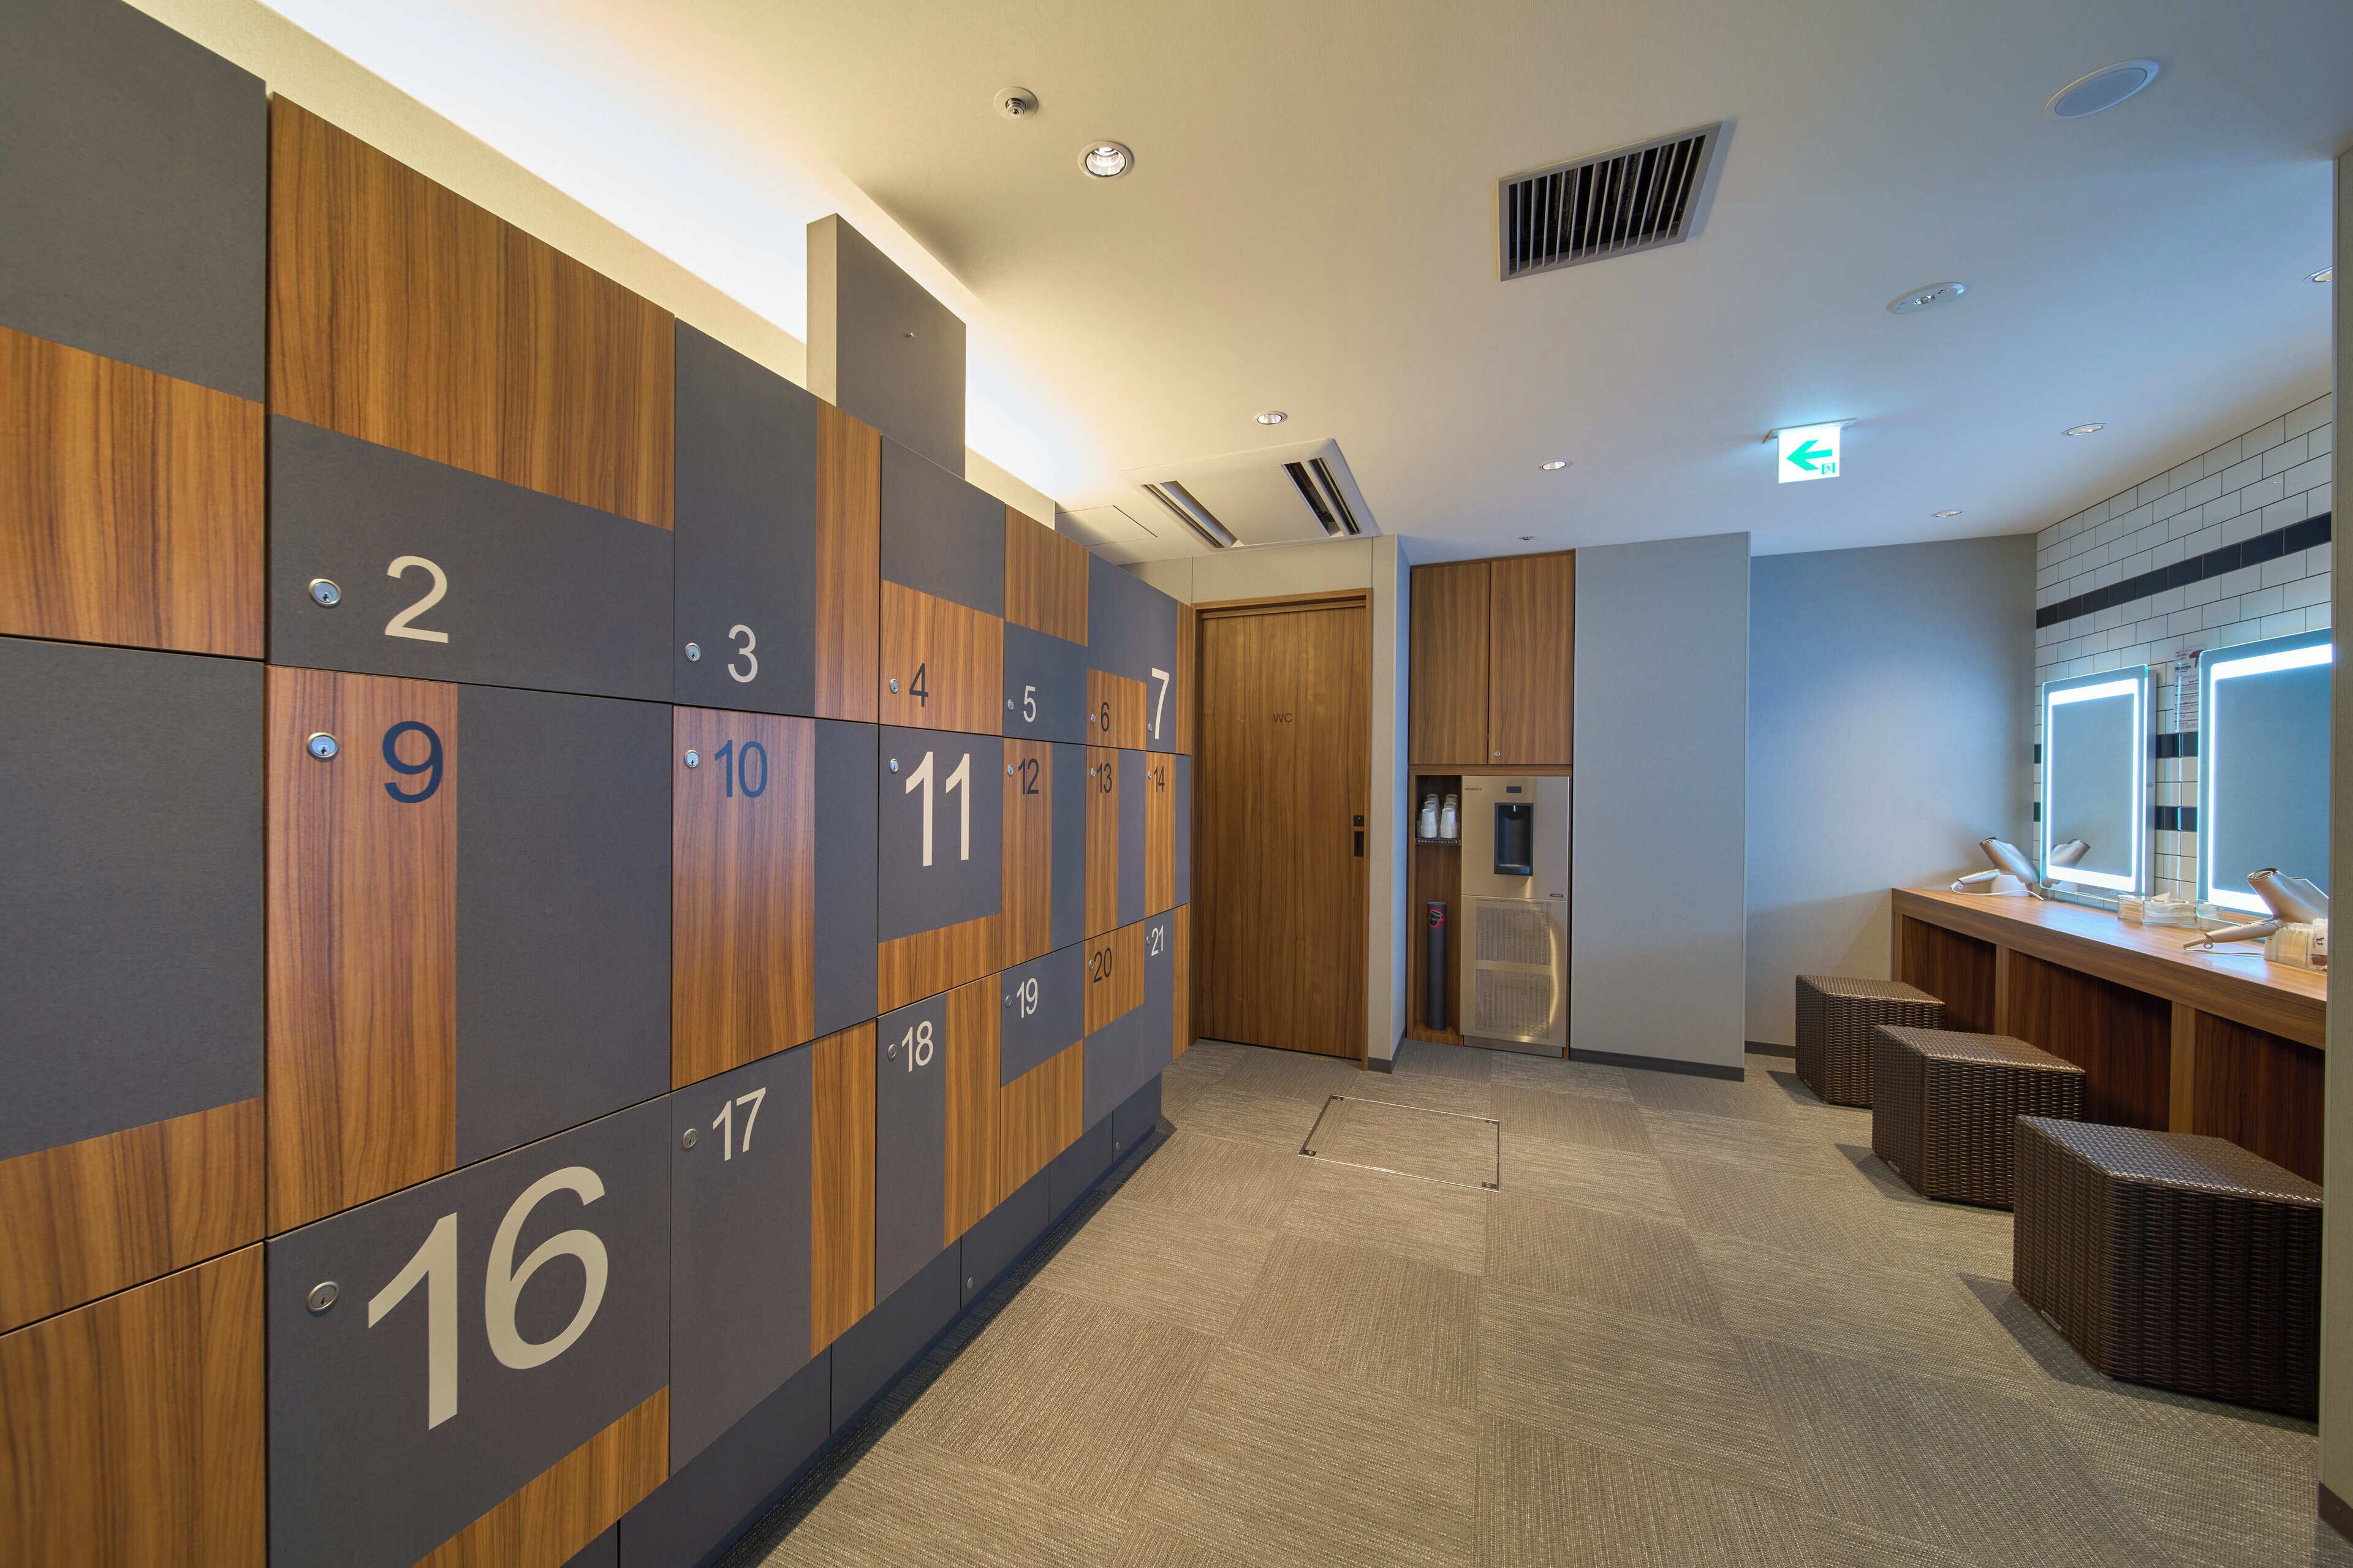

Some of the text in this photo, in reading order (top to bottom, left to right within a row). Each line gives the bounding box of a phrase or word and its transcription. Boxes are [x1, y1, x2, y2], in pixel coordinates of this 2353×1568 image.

[384, 555, 449, 643] 2
[727, 624, 759, 683] 3
[909, 663, 929, 707] 4
[1023, 685, 1037, 723] 5
[1151, 667, 1170, 740] 7
[1101, 702, 1110, 732] 6
[1273, 713, 1293, 723] WC
[382, 721, 444, 804] 9
[714, 740, 768, 798] 10
[1018, 758, 1040, 795] 12
[1096, 763, 1112, 793] 13
[1153, 765, 1165, 792] 14
[906, 751, 971, 867] 11
[1151, 925, 1164, 956] 21
[1093, 947, 1112, 983] 20
[1017, 978, 1038, 1019] 19
[901, 1021, 934, 1072] 18
[713, 1087, 766, 1162] 17
[368, 1166, 608, 1431] 16
